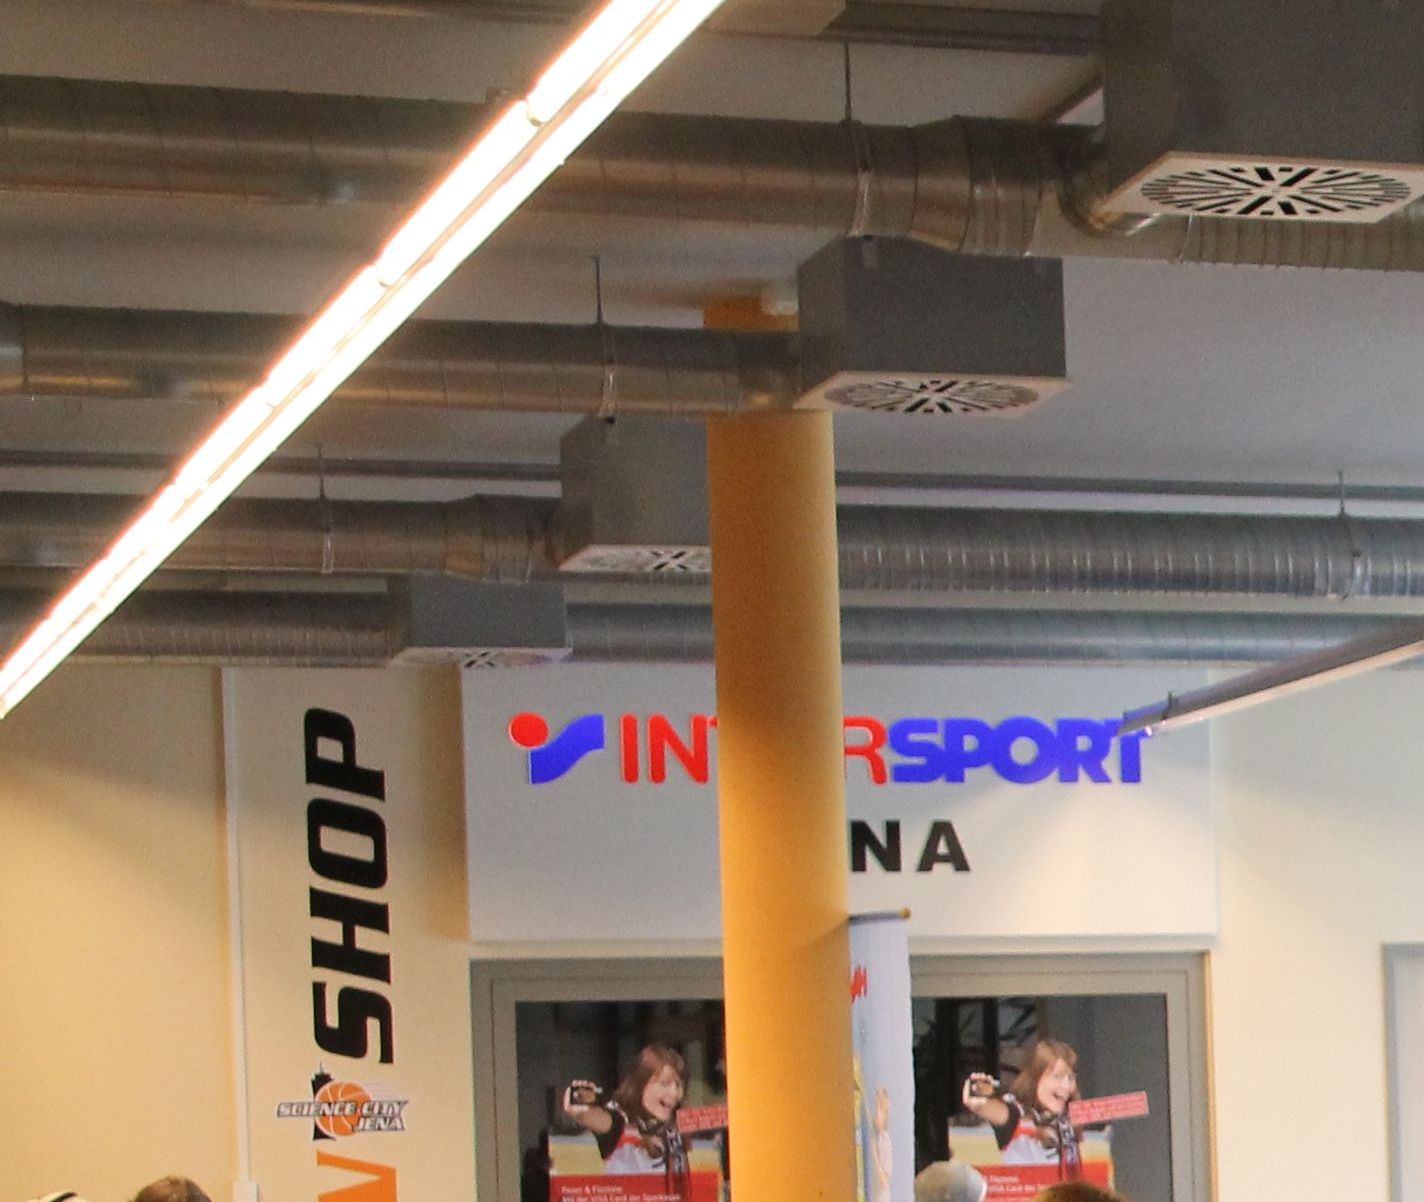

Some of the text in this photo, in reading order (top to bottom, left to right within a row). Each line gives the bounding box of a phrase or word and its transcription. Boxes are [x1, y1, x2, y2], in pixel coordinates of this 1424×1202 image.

[619, 714, 1149, 785] INRSPORT
[850, 820, 972, 873] NA
[303, 708, 395, 1065] SHOP
[276, 1100, 409, 1118] SCIENCE CITY
[353, 1116, 405, 1132] JENA
